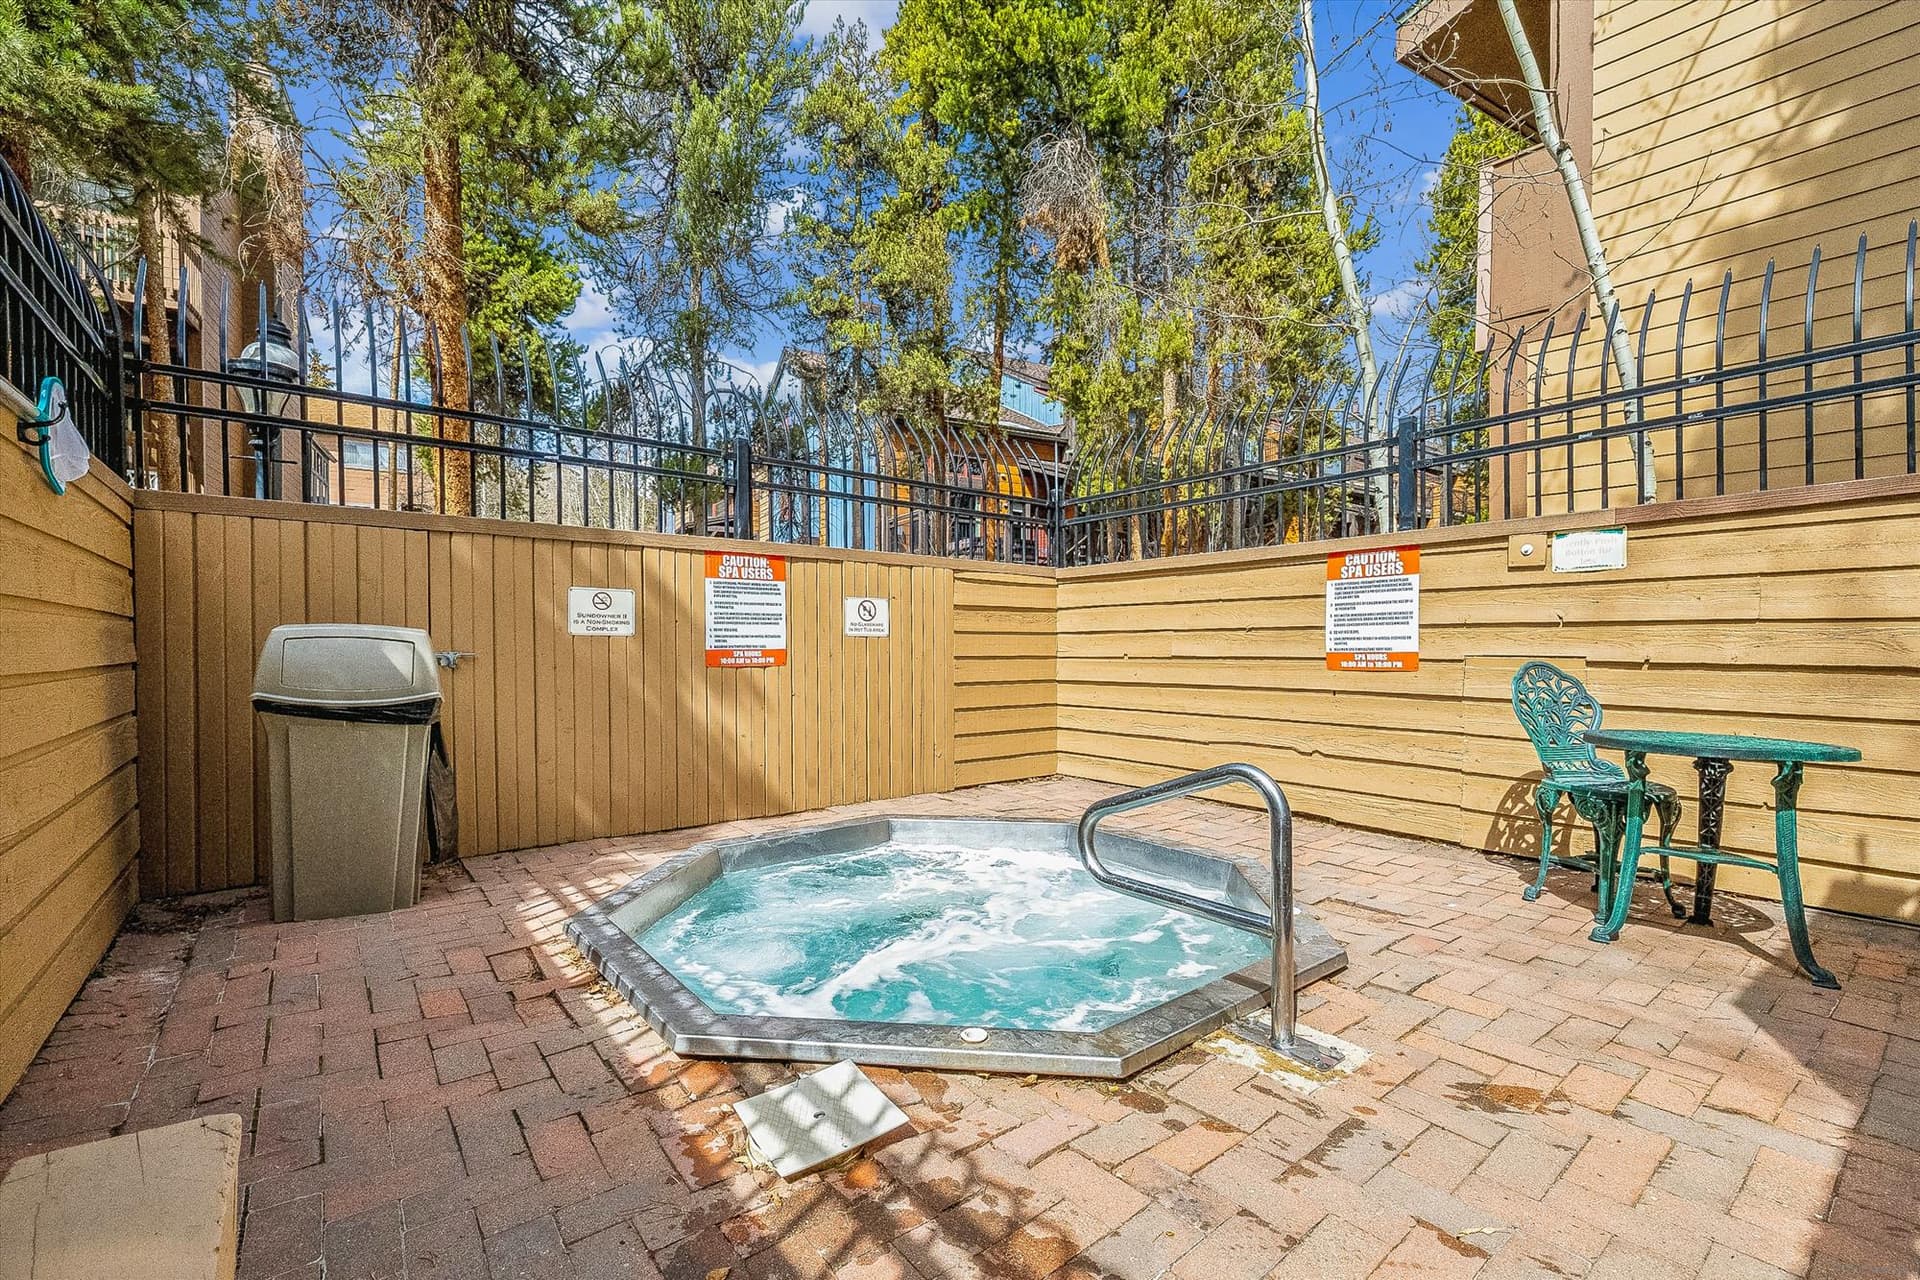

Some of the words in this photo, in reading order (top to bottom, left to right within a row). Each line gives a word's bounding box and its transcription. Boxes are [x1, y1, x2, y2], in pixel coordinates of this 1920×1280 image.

[722, 554, 770, 568] CAUTION:
[1345, 550, 1400, 566] CAUTION:
[718, 565, 740, 578] SPA
[741, 566, 774, 580] USERS
[1340, 565, 1363, 579] SPA
[1365, 561, 1404, 577] USERS
